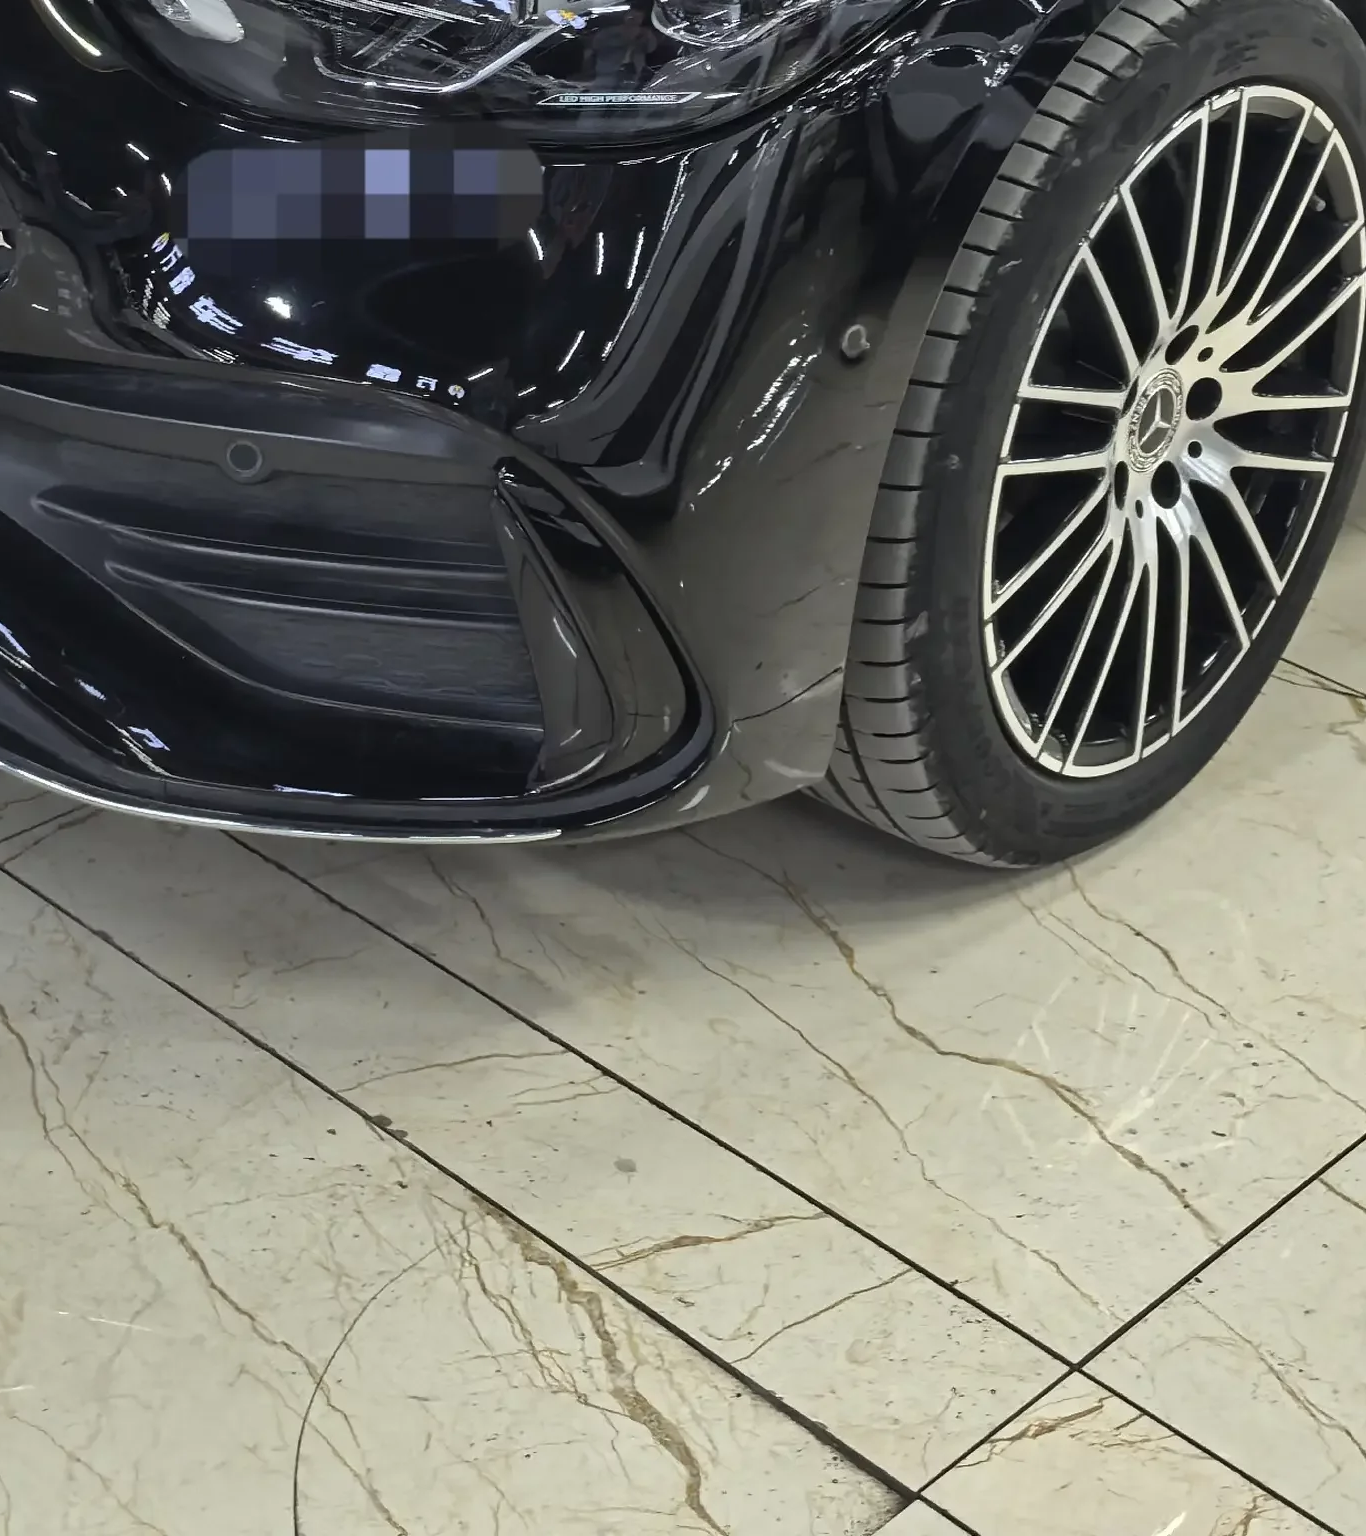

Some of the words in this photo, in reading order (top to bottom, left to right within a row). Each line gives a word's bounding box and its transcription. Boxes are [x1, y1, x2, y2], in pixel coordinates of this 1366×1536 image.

[559, 95, 578, 103] LED
[580, 95, 604, 103] HIGH
[606, 94, 678, 103] PERFORMANCE
